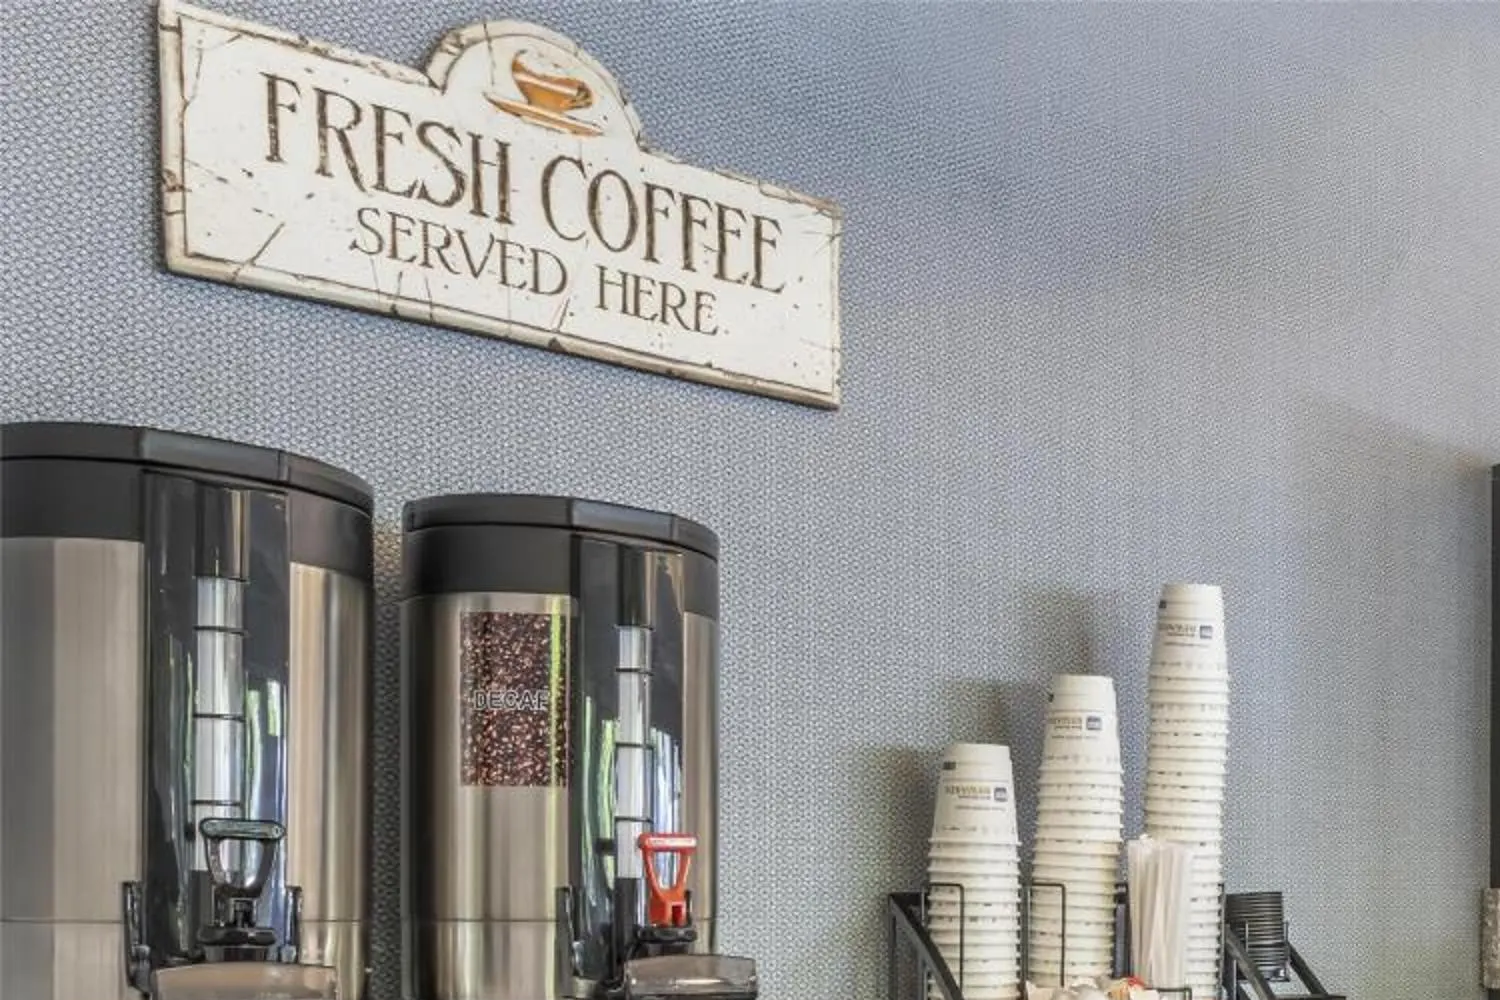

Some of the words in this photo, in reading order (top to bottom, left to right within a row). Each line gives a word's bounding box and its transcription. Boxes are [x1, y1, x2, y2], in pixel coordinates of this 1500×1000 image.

[260, 71, 514, 226] FRESH
[540, 153, 786, 295] COFFEE
[348, 206, 568, 297] SERVED
[594, 263, 720, 337] HERE
[474, 689, 549, 711] DECAF
